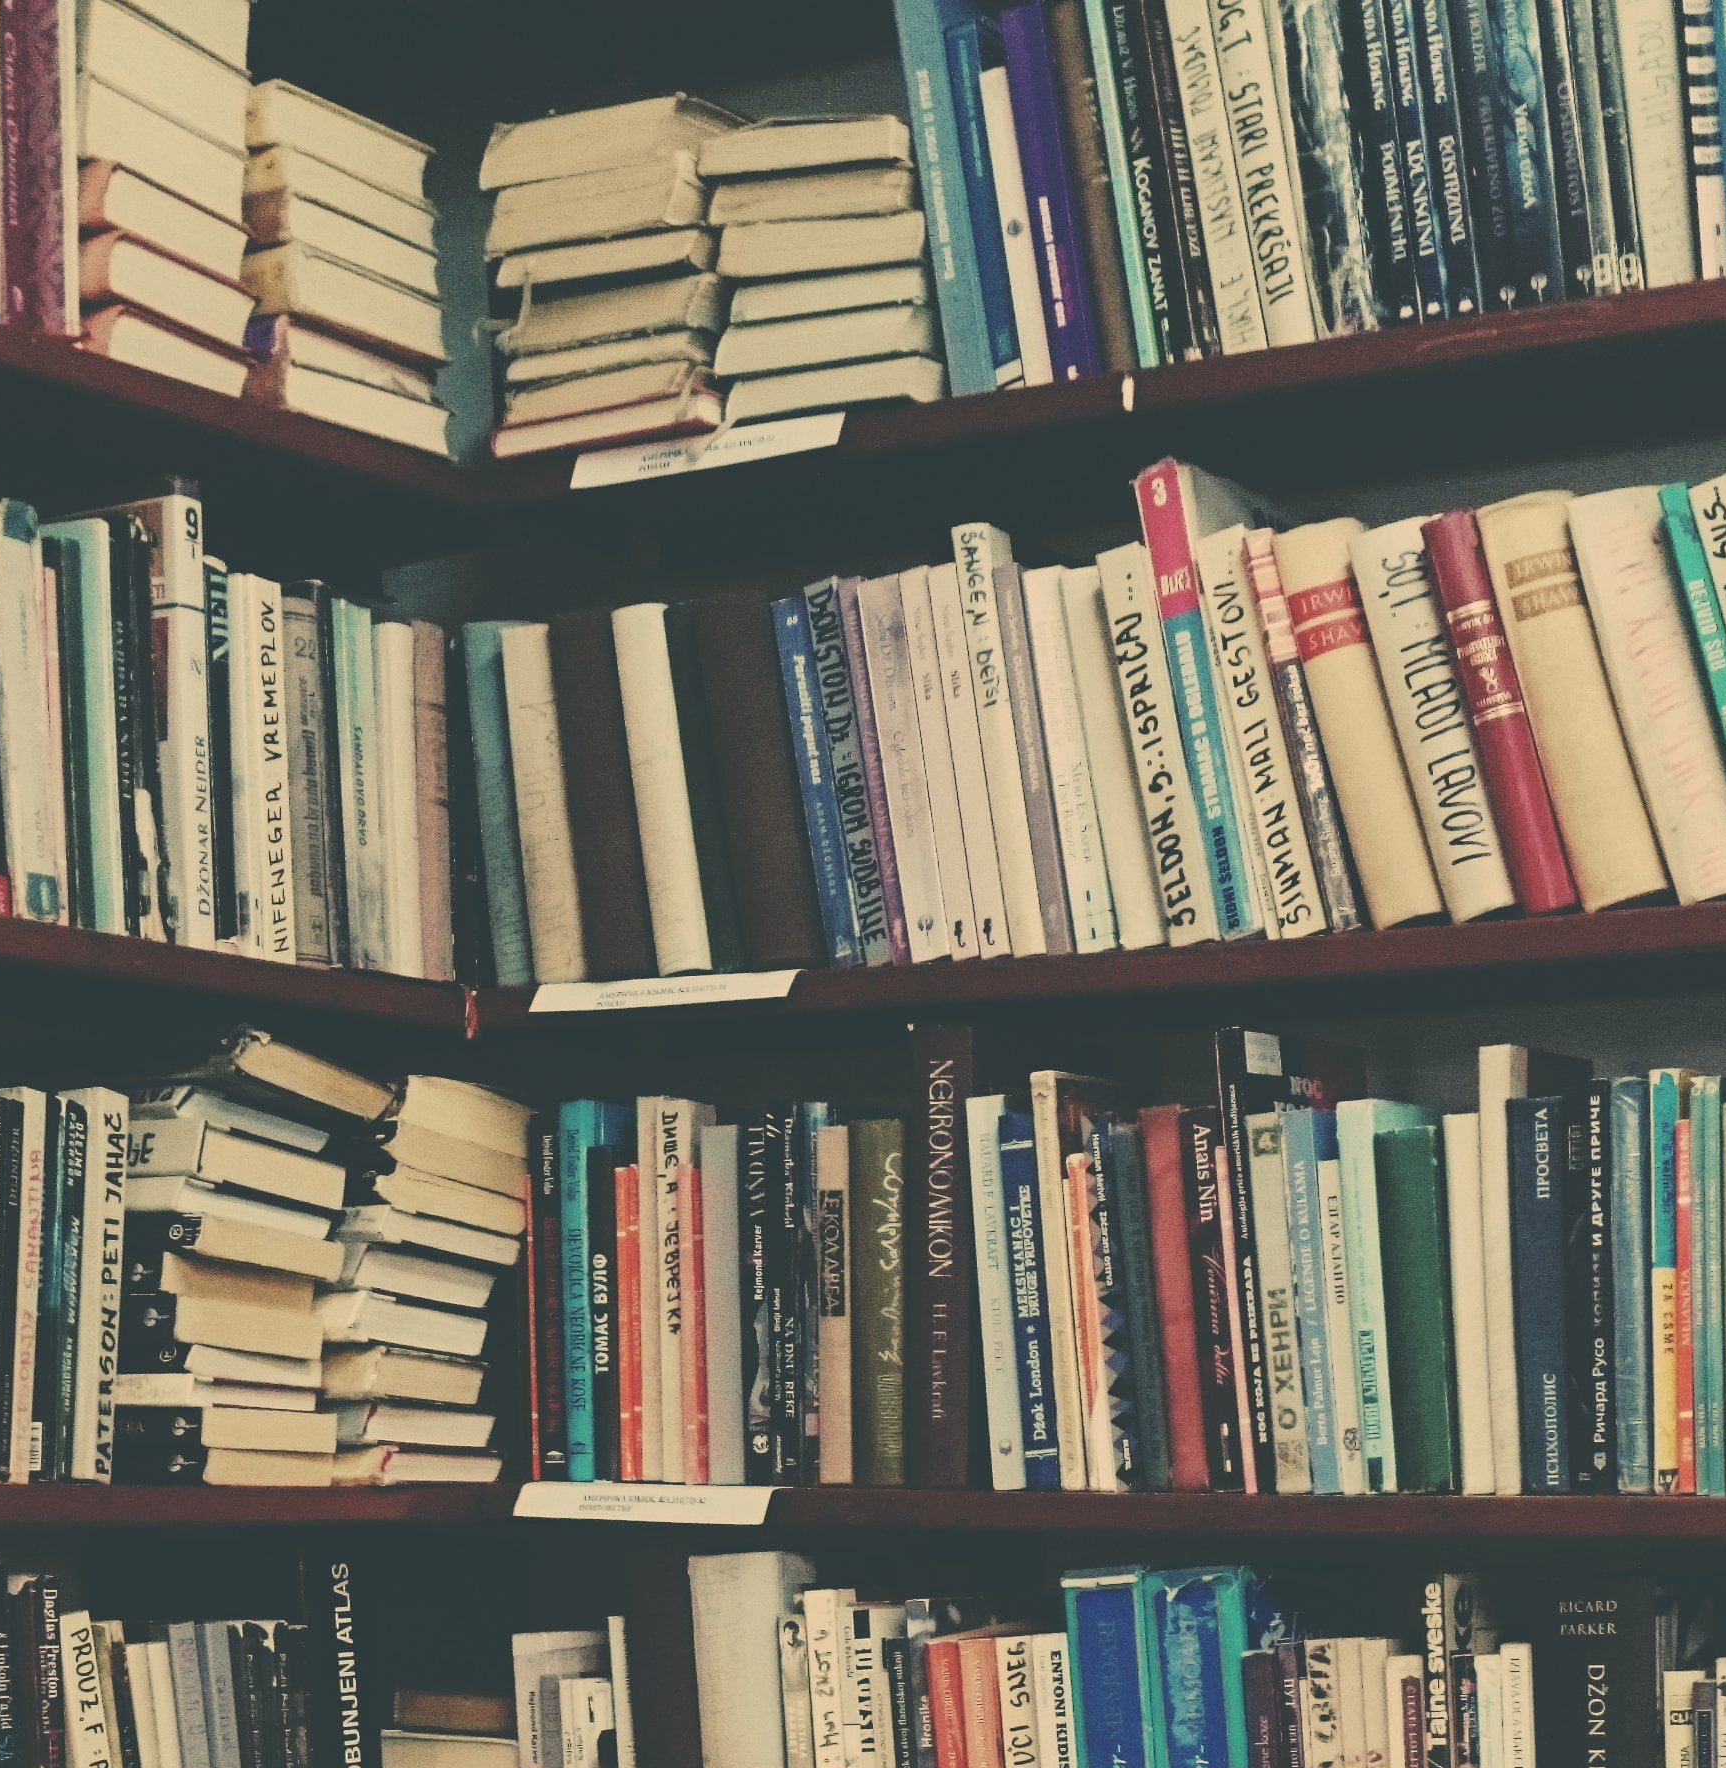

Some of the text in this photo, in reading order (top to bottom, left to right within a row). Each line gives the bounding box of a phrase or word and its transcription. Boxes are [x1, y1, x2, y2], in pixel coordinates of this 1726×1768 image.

[1145, 255, 1169, 312] ZANAT
[1399, 636, 1492, 869] MLADI LAVOVI
[100, 1108, 125, 1284] PETI JAHAČ
[1191, 1122, 1219, 1223] Anais Nin
[1533, 1106, 1549, 1197] ПРОСВЕТА
[750, 1224, 765, 1300] Rejmond Karver
[1019, 1184, 1040, 1315] DRUGE PRIPOVETKE
[1588, 1094, 1609, 1443] Ричард Русо И ДРУГЕ ПРИЧЕ
[591, 1252, 610, 1373] ТОМАС ВУЛФ
[1265, 1285, 1296, 1390] ХЕНРИ
[1543, 1371, 1560, 1484] ПСИХОПОЛИС
[42, 1588, 64, 1698] Daglas Preston
[331, 1562, 353, 1644] ATLAS
[1048, 1650, 1068, 1718] ENTONI
[1422, 1583, 1451, 1750] Tajne sveske
[1587, 1664, 1611, 1735] DŽON
